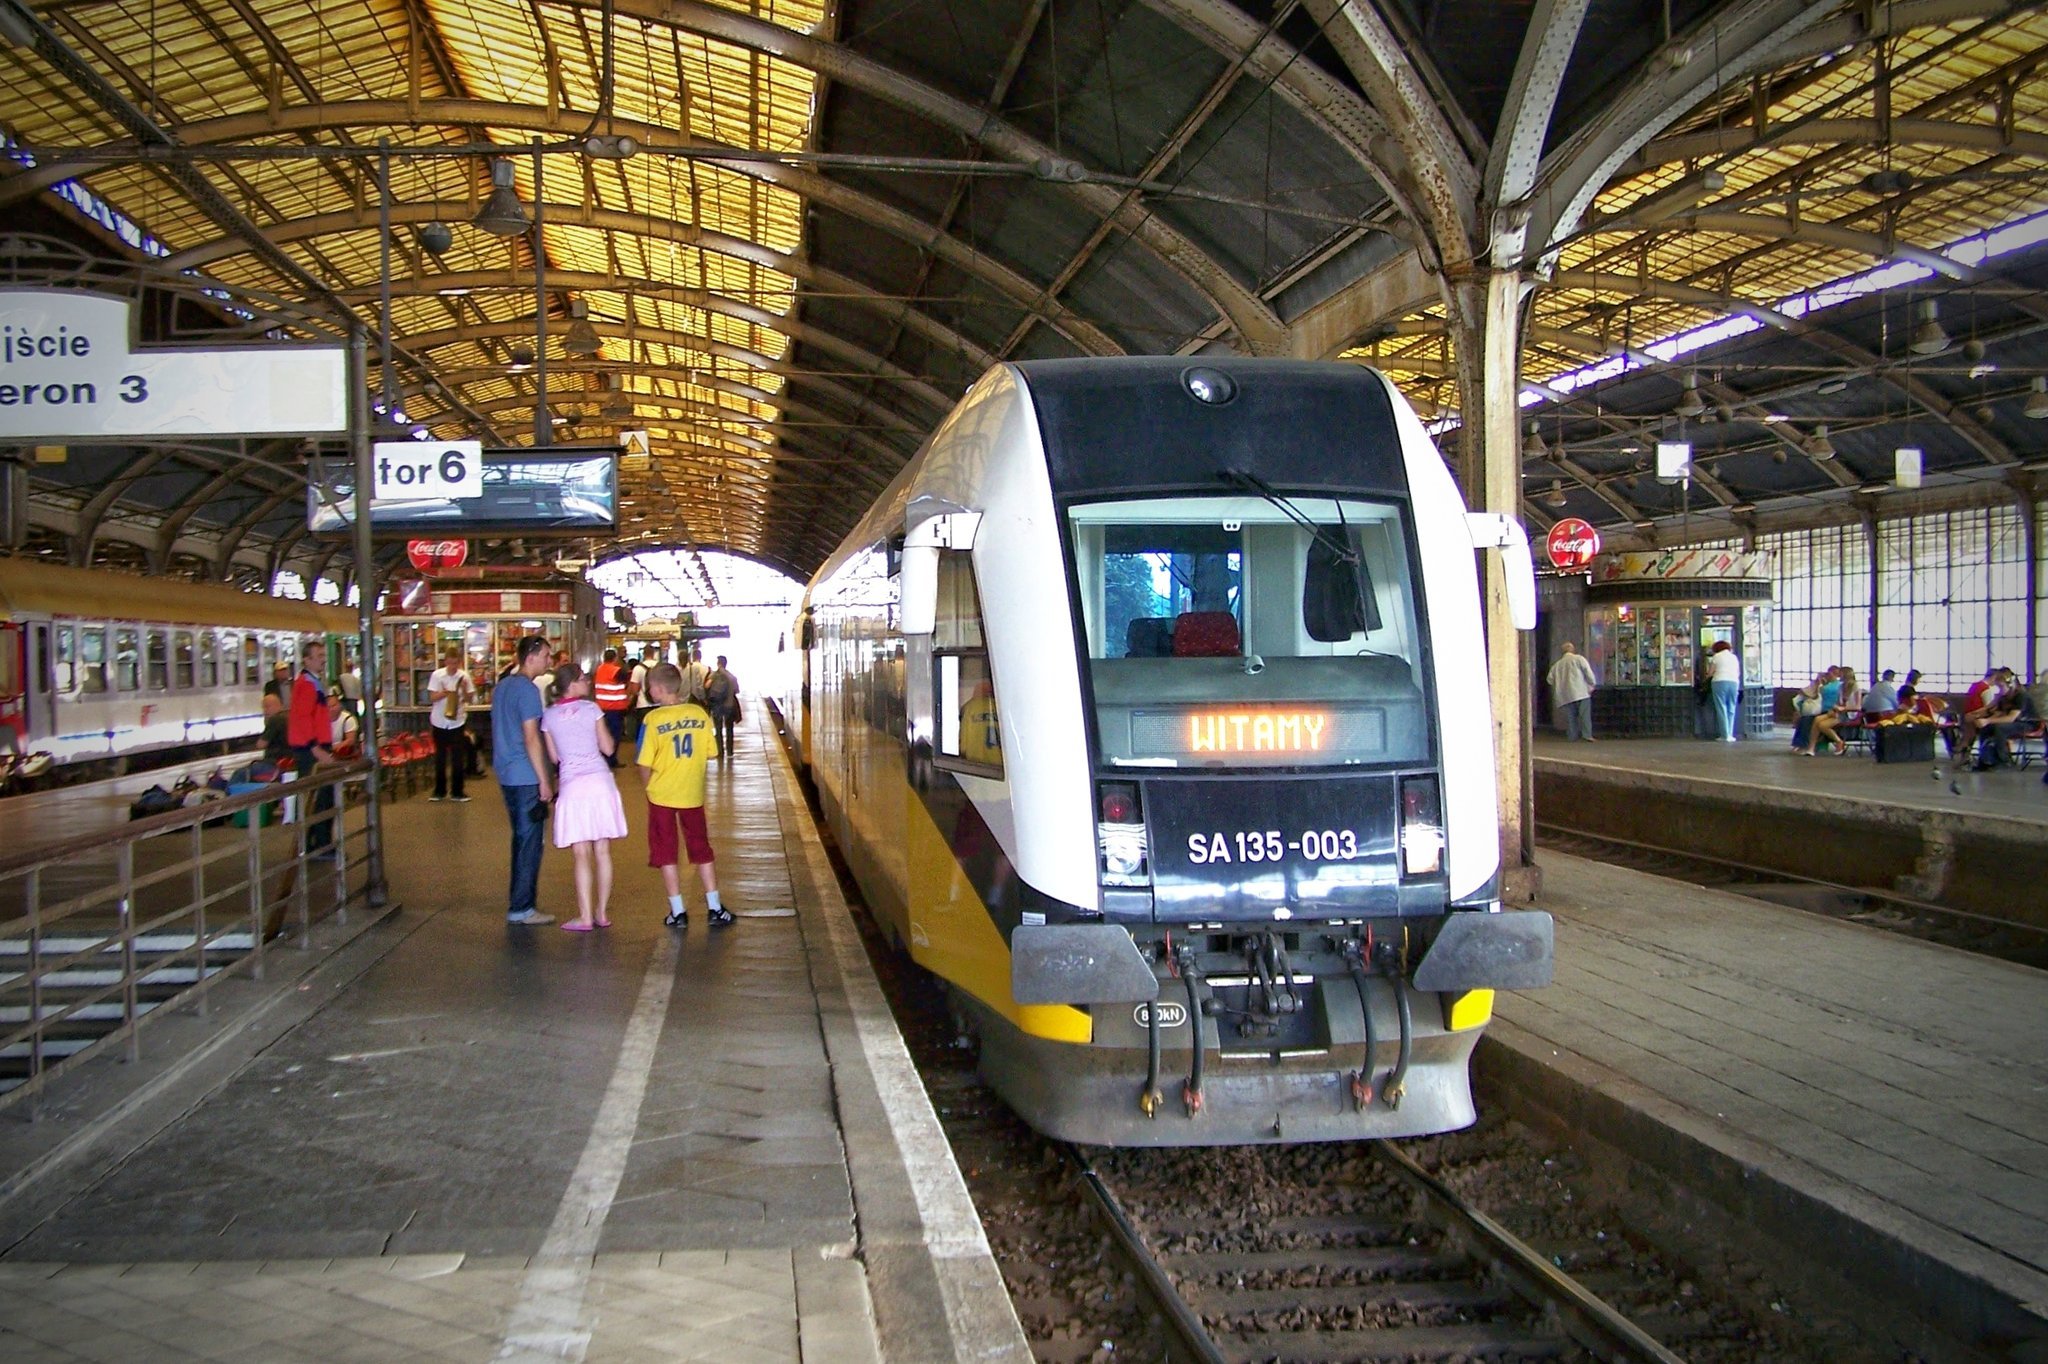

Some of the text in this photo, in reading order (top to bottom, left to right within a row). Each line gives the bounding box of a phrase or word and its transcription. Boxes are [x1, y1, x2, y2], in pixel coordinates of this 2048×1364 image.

[119, 375, 149, 404] 3
[379, 450, 466, 485] tor 6
[1552, 539, 1593, 552] Coca-C
[657, 716, 705, 734] BŁAŻEJ
[1191, 714, 1325, 751] WITAMY
[673, 733, 693, 758] 14
[1141, 1008, 1180, 1021] 80kN
